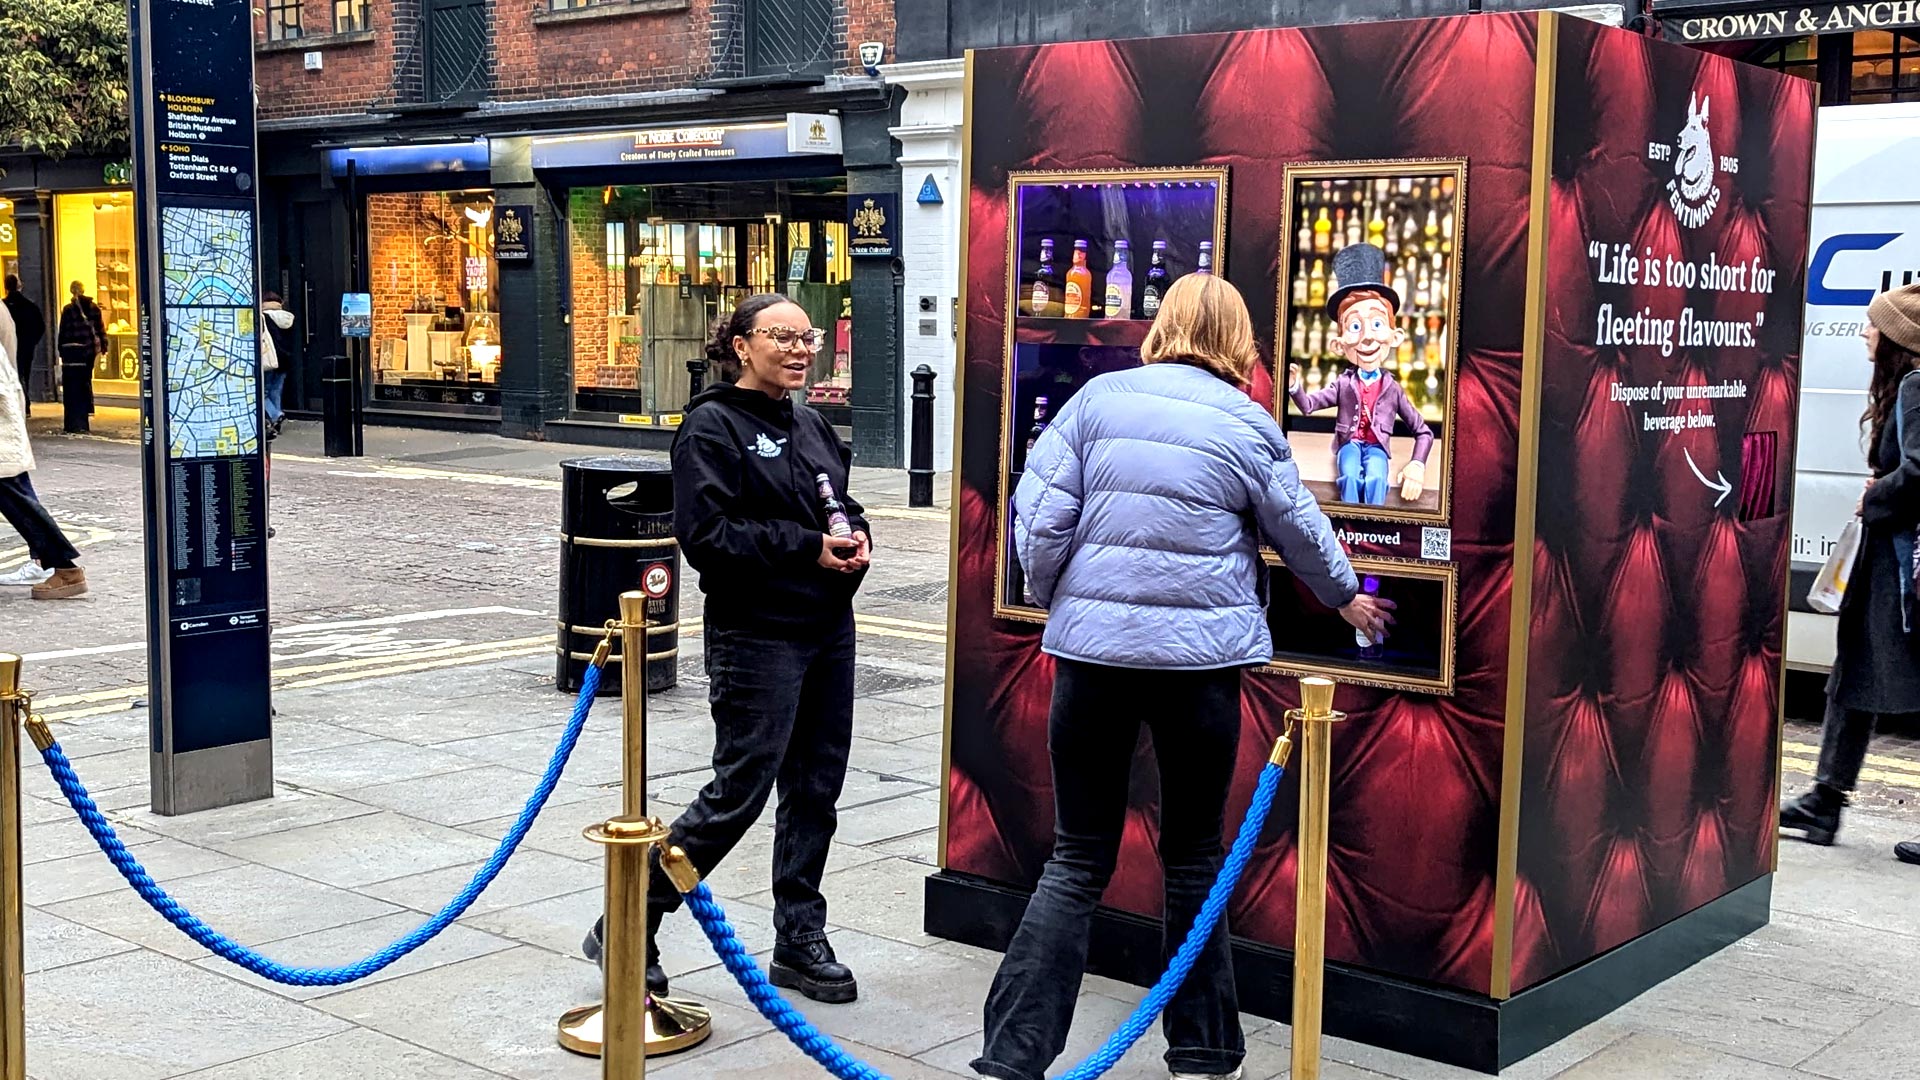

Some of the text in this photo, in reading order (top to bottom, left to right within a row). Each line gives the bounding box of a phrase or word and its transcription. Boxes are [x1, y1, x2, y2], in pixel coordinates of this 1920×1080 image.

[1683, 10, 1788, 40] CROWN
[1795, 8, 1818, 32] &
[167, 94, 215, 105] BLOOMSBURY
[167, 104, 203, 113] HOLBORN
[168, 112, 237, 125] Shaftesbury Avenue
[168, 122, 223, 133] British Museum
[168, 130, 197, 140] Holborn
[168, 144, 190, 153] SOHO
[621, 148, 735, 162] Creators of Finely Crafted Treasures
[169, 154, 209, 163] Seven Dials
[1719, 155, 1739, 174] 1905
[169, 162, 229, 173] Tottenham Ct Rd
[169, 172, 218, 182] Oxford Street
[1665, 178, 1721, 229] FENTIMANS
[1589, 240, 1776, 294] “Life is too short for
[1596, 303, 1764, 357] fleeting flavours.”
[1610, 380, 1747, 406] Dispose of your unremarkable
[1643, 409, 1716, 435] beverage below.
[1337, 528, 1401, 546] Approved
[189, 621, 209, 629] Camden
